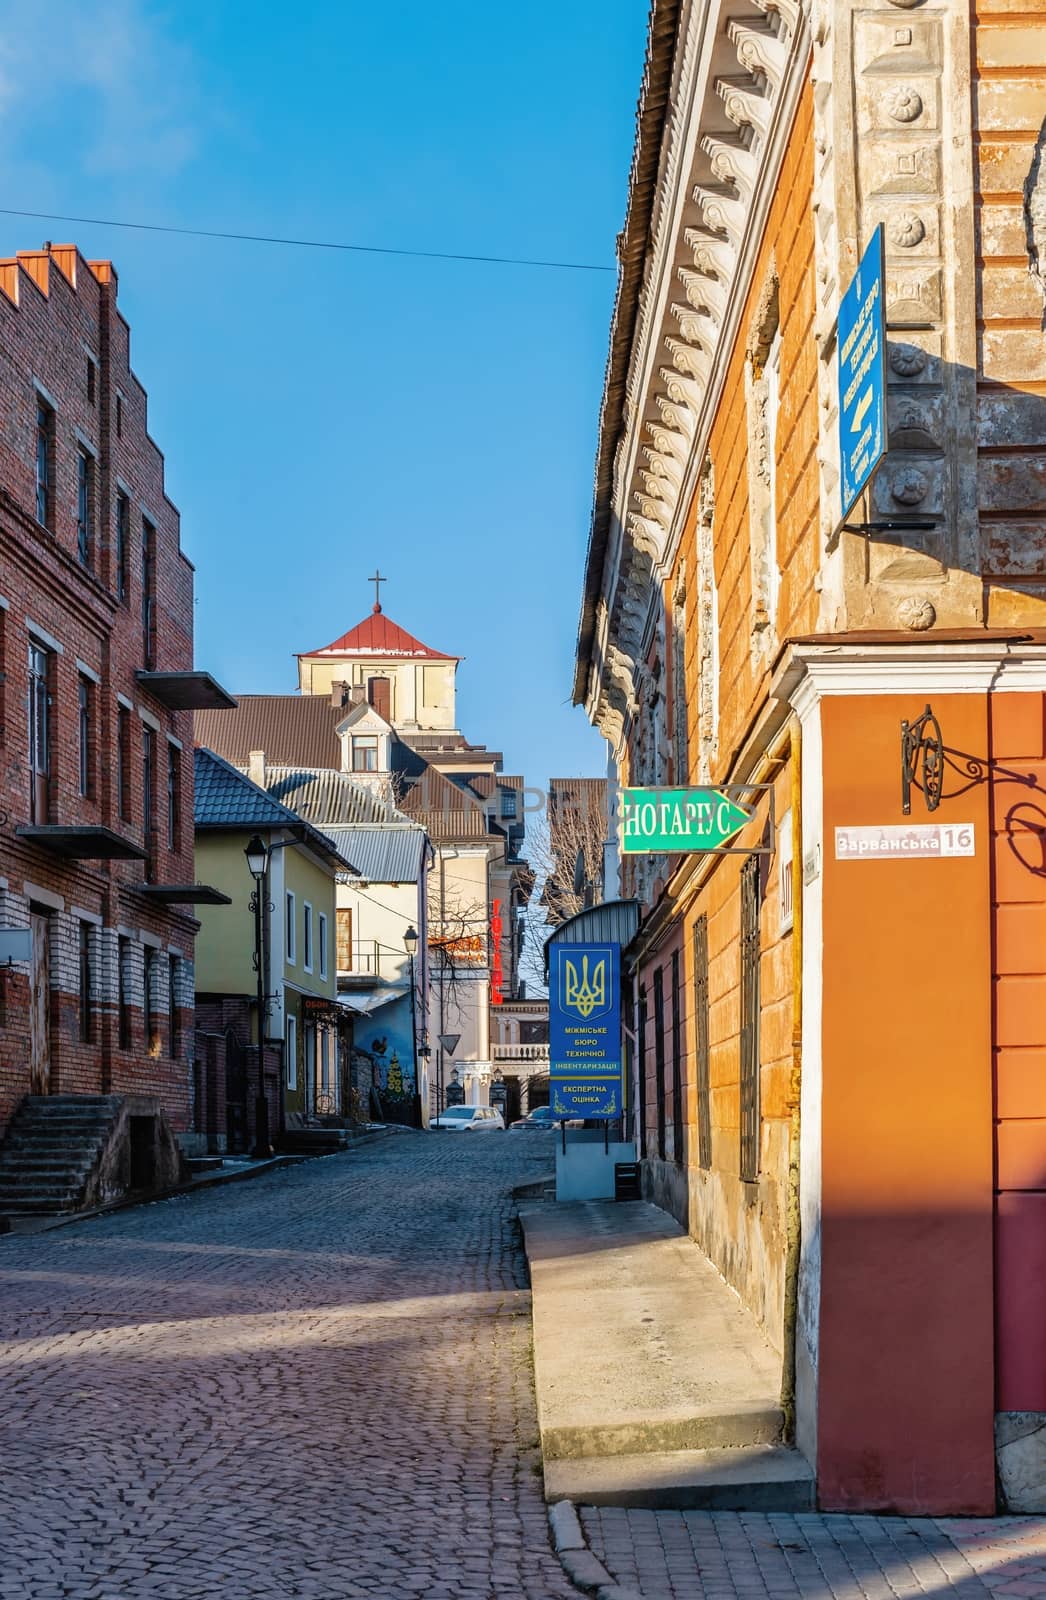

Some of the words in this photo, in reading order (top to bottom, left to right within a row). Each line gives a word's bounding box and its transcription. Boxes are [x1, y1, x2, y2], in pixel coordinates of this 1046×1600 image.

[623, 801, 731, 836] НОТАРІУС
[838, 837, 940, 854] Зарванська
[944, 829, 972, 848] 16
[566, 1049, 606, 1057] ТЕХНІЧНОЇ
